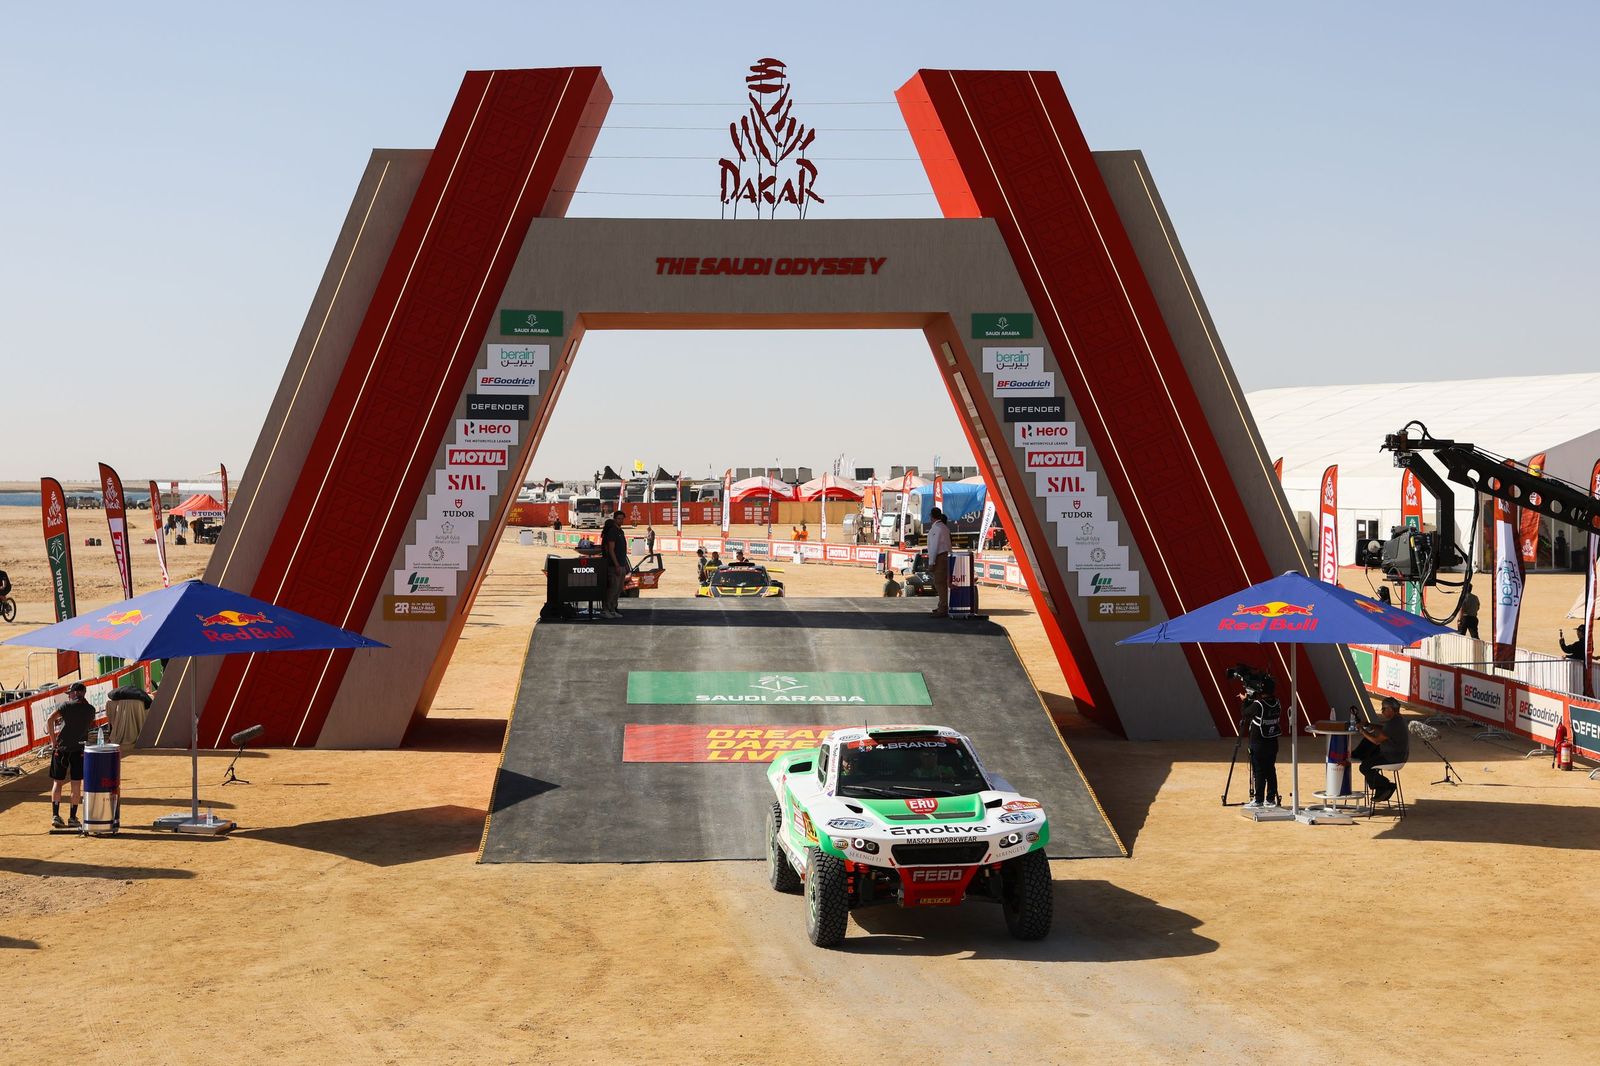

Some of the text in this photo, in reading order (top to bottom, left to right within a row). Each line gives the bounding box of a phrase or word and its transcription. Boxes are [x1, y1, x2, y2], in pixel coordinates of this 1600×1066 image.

[719, 158, 824, 205] DAKAR
[656, 257, 888, 275] THE SAUDI ODYSSEY
[501, 348, 535, 360] berain
[996, 350, 1030, 363] berain
[481, 377, 535, 385] BFGoodrich
[997, 380, 1051, 388] BFGoodrich
[471, 403, 525, 411] DEFENDER
[479, 424, 512, 434] Hero
[1036, 427, 1069, 436] Hero
[452, 451, 504, 463] MOTUL
[1030, 453, 1082, 465] MOTUL
[56, 568, 66, 608] ARABIA
[1216, 617, 1317, 631] Red Bull
[201, 625, 294, 642] Red Bull
[774, 695, 866, 703] ARABIA
[1465, 684, 1501, 706] BFGoodrich
[1519, 700, 1559, 724] BFGoodrich
[706, 750, 788, 761] LIV
[909, 799, 936, 809] ERU
[938, 836, 977, 844] WORKWEAR
[912, 869, 963, 882] FEBO
